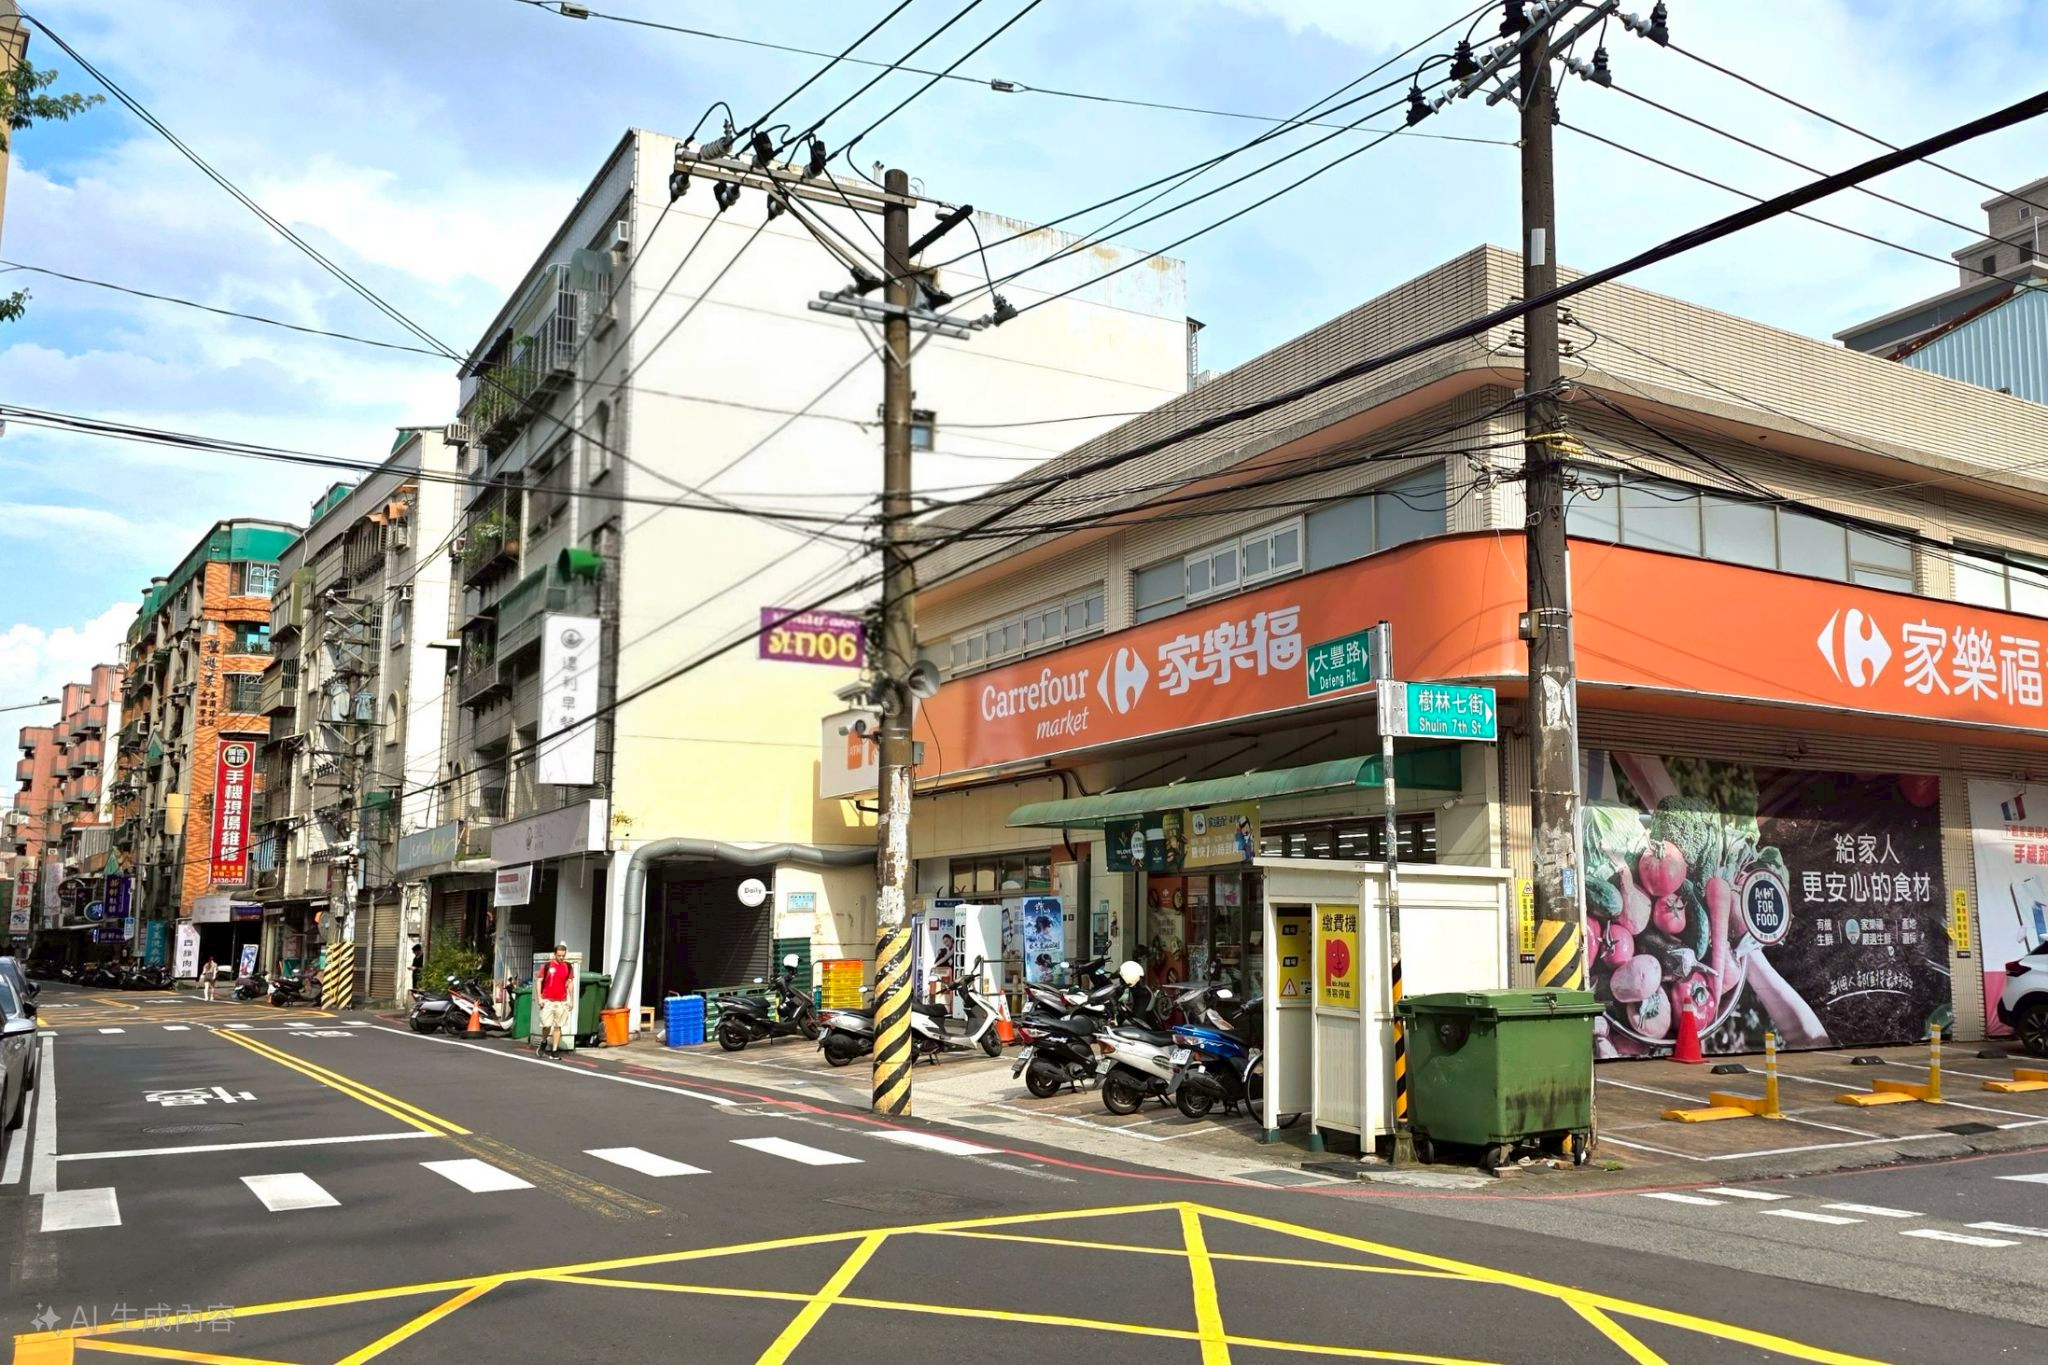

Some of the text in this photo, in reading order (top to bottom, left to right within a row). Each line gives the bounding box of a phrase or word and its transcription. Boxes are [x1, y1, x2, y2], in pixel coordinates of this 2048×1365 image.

[1158, 606, 1302, 696] 家樂福
[1314, 640, 1361, 673] 大豐路
[1903, 618, 2046, 706] 家樂福
[1320, 669, 1358, 690] Dafeng Rd.
[981, 668, 1089, 722] Carrefour
[1419, 689, 1484, 715] 樹林七街
[1036, 706, 1089, 740] market
[1419, 717, 1485, 735] Shulin 7th St.
[220, 769, 244, 861] 手機現場維修
[1834, 833, 1900, 864] 給家人
[744, 887, 762, 895] Daily
[1802, 871, 1931, 903] 更安心的食材
[1757, 900, 1774, 913] FOR
[1322, 913, 1357, 933] 繳費機
[1756, 913, 1778, 926] FOOD
[1816, 918, 1832, 931] 有機
[1861, 918, 1884, 931] 家樂福
[1817, 933, 1834, 946] 生鮮
